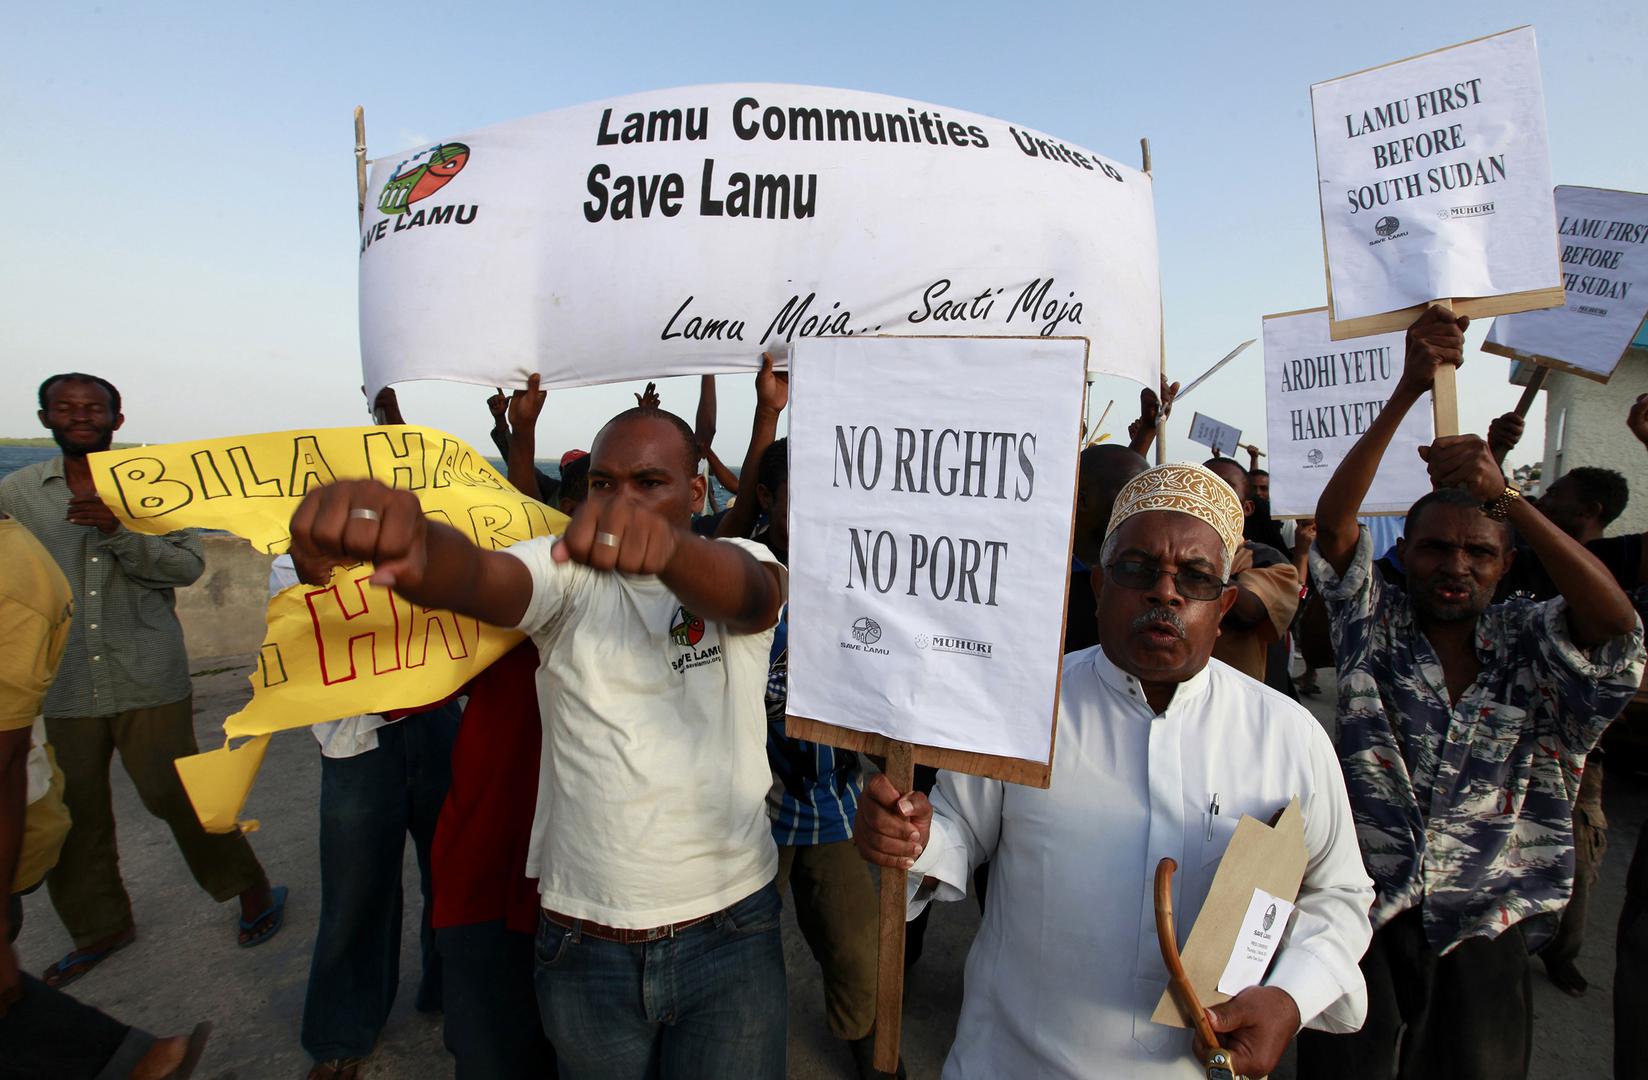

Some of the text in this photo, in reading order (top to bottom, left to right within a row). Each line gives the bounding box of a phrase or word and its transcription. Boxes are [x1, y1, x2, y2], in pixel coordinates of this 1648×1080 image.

[1345, 78, 1482, 139] LAMU FIRST
[597, 97, 1123, 182] Lamu Communities Unite to
[1372, 123, 1466, 170] BEFORE
[583, 158, 817, 223] Save Lamu
[1347, 153, 1506, 215] SOUTH SUDAN
[360, 204, 478, 258] AVE LAMU
[1450, 203, 1494, 216] MUHURI
[1558, 216, 1648, 244] LAMU FIRST
[1369, 231, 1409, 246] SAVE LAMU
[1561, 245, 1624, 270] BEFORE
[908, 278, 1083, 337] Sauti Moja
[1577, 275, 1632, 300] SUDAN
[661, 296, 745, 341] Lamu
[1281, 346, 1391, 392] ARDHI YETU
[1290, 400, 1387, 441] HAKI YET
[110, 435, 337, 519] BILA
[833, 425, 1037, 502] NO RIGHTS
[846, 528, 1008, 606] NO PORT
[840, 641, 890, 656] SAVE LAMU
[932, 637, 992, 654] MUHURI
